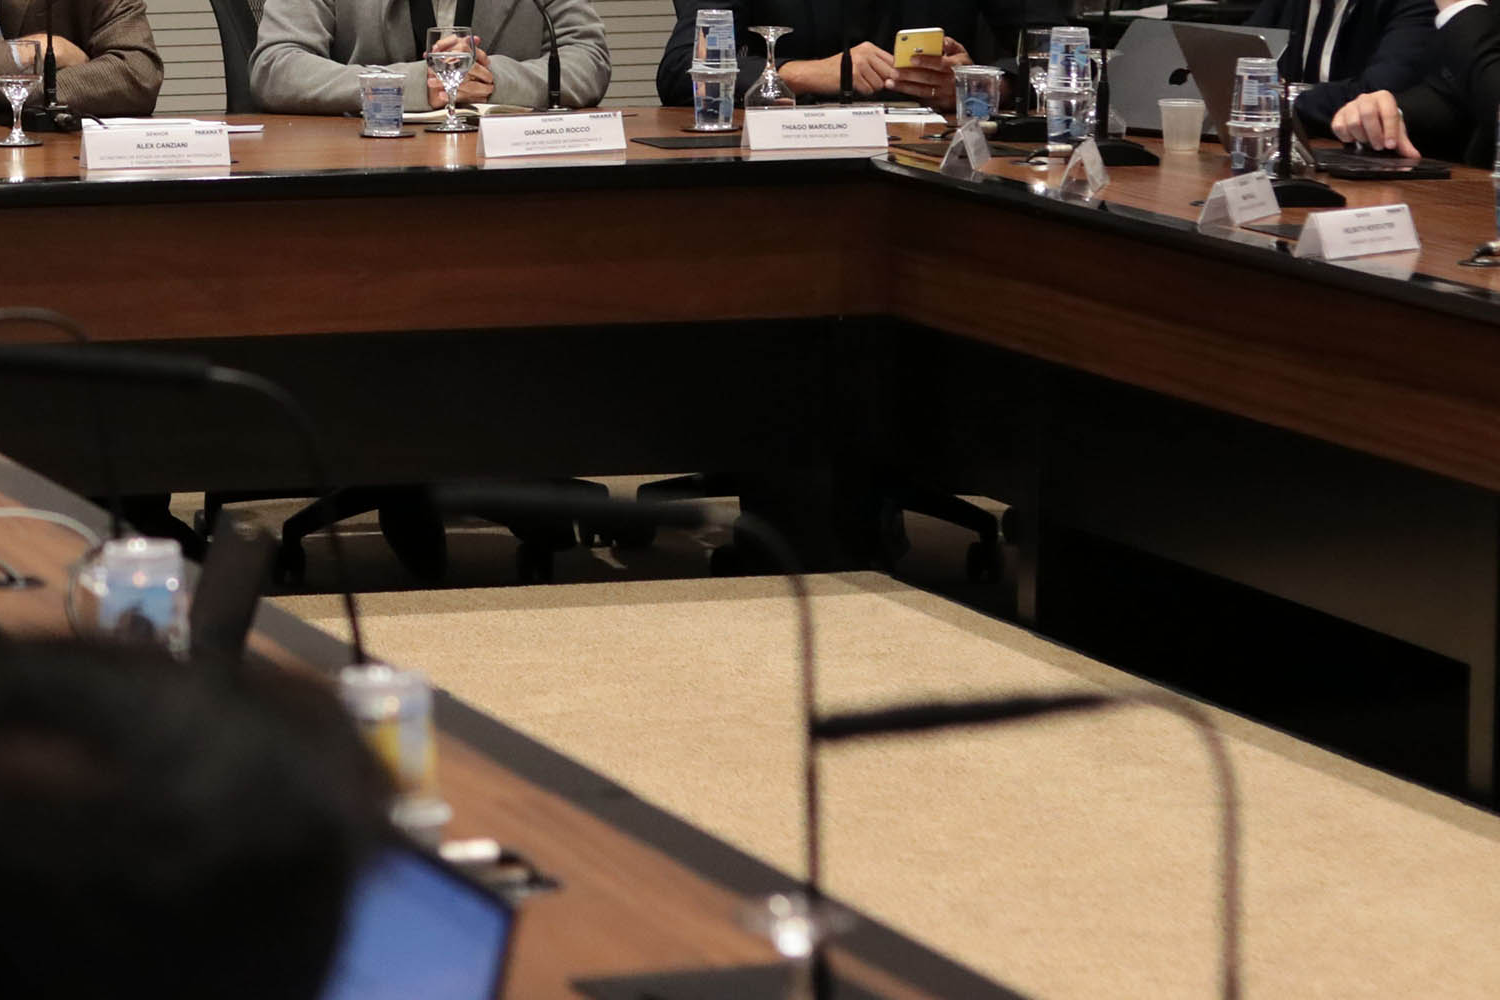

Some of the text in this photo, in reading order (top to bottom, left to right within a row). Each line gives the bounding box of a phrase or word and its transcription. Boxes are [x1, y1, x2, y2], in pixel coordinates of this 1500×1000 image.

[524, 126, 591, 136] GIANCARLO ROCCO
[781, 122, 848, 131] THIAGO MARCELINO
[136, 141, 188, 150] ALEX CANZIANI
